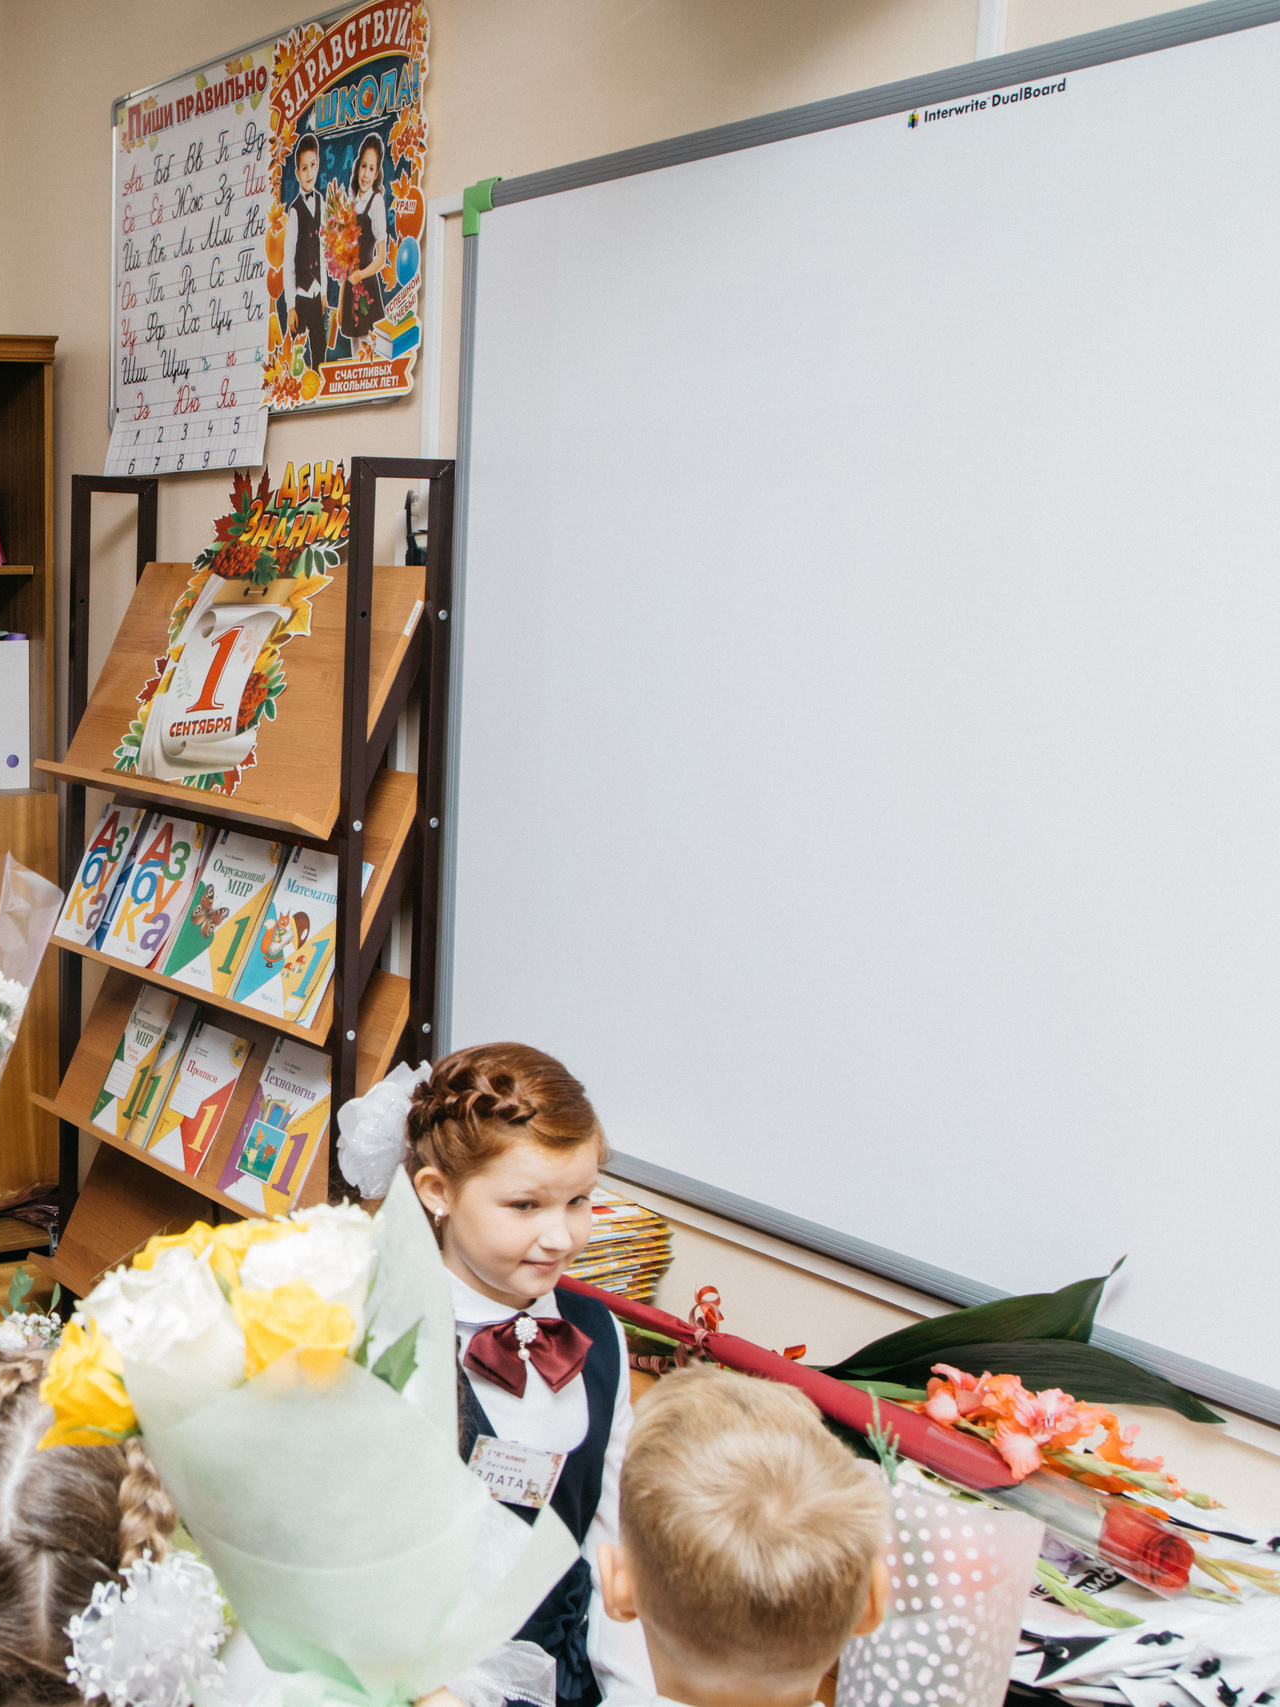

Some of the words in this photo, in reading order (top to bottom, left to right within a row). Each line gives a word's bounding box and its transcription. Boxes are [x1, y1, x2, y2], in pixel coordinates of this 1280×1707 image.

[176, 65, 268, 123] ПРАВИЛЬНО
[315, 58, 420, 134] ШКОЛА!
[924, 99, 987, 123] Interwrite
[991, 78, 1066, 107] DualBoard
[395, 200, 417, 213] УРА!!!
[385, 272, 421, 316] УСПЕШНОЙ
[329, 378, 378, 393] ШКОЛЬНЫХ
[379, 375, 399, 388] ЛЕТ!
[334, 364, 393, 381] СЧАСТЛИВЫХ
[133, 429, 141, 446] 1
[157, 426, 164, 443] 2
[180, 422, 188, 441] 3
[207, 420, 214, 437] 4
[233, 416, 241, 434] 5
[128, 458, 136, 475] 6
[153, 456, 161, 473] 7
[176, 453, 185, 471] 8
[202, 450, 210, 468] 9
[227, 448, 237, 466] 0
[276, 459, 345, 509] ДЕНЬ
[186, 625, 244, 713] 1
[169, 716, 232, 737] СЕНТЯБРЯ
[213, 859, 266, 884] Окружающий
[224, 878, 253, 898] МИР
[217, 916, 251, 975] 1
[291, 938, 331, 998] 1
[132, 1029, 154, 1049] МИР
[186, 1059, 219, 1084] Прописи
[264, 1065, 317, 1102] Технология
[122, 1065, 150, 1120] 1
[187, 1104, 219, 1153] 1
[271, 1132, 309, 1197] 1
[505, 1455, 527, 1464] класс
